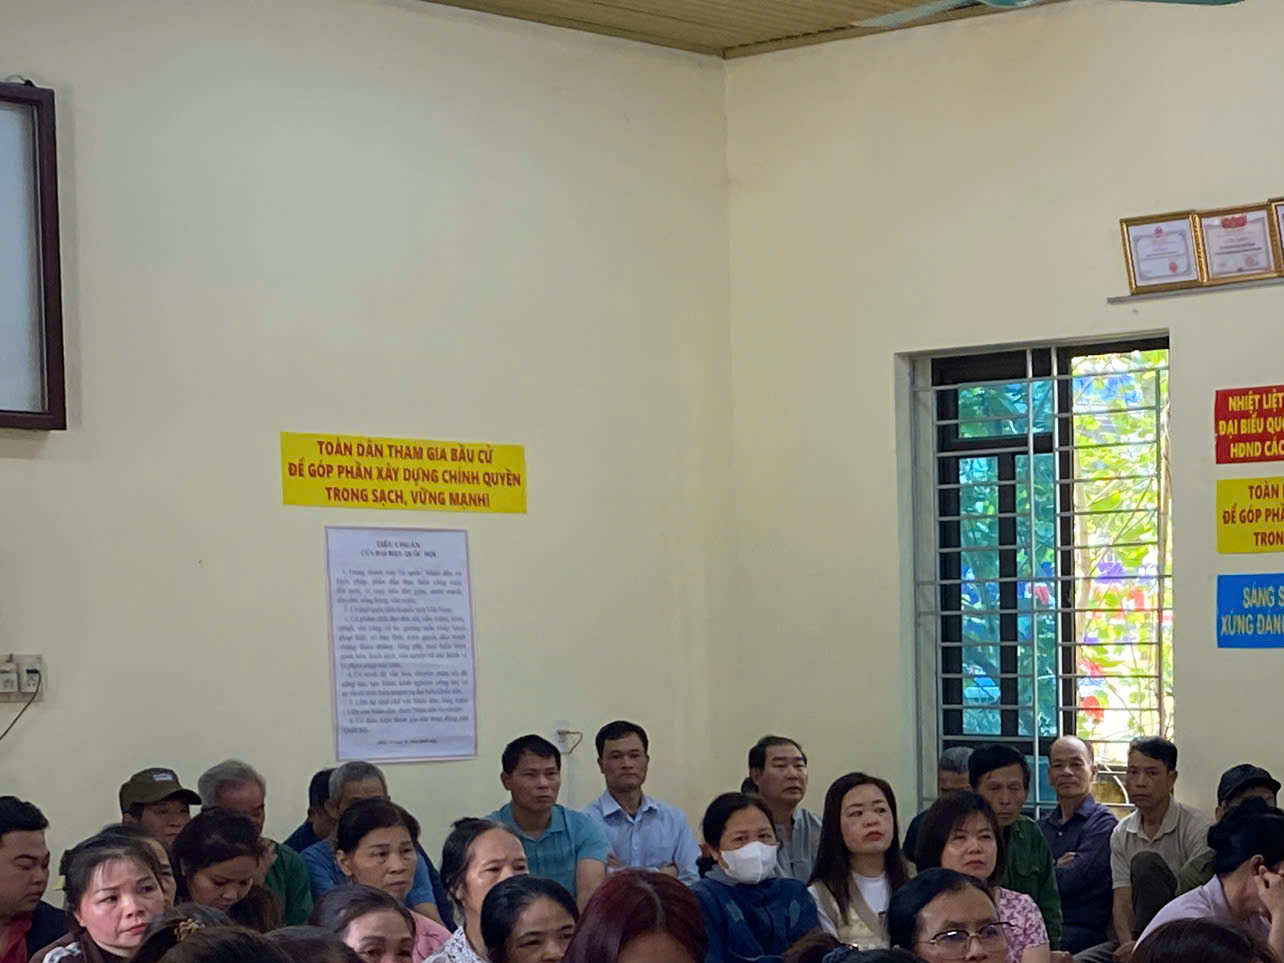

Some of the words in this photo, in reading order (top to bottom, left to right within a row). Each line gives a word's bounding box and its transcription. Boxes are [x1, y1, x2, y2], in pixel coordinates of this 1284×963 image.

[1228, 389, 1261, 414] NHIỆT
[1262, 387, 1284, 413] LIỆT
[1218, 419, 1239, 440] ĐẠI
[1240, 411, 1265, 435] BIỂU
[317, 436, 353, 456] TOÀN
[356, 438, 384, 458] DÂN
[387, 444, 424, 460] THAM
[426, 446, 449, 462] GIA
[450, 443, 475, 464] BẦU
[477, 444, 494, 465] CỬ
[288, 456, 305, 478] ĐỂ
[308, 459, 334, 479] GÓP
[337, 461, 373, 481] PHẦN
[376, 462, 400, 482] XÂY
[403, 467, 440, 486] DỰNG
[441, 466, 481, 485] CHÍNH
[482, 466, 522, 488] QUYỀN
[325, 487, 369, 502] TRONG
[411, 486, 446, 506] VỮNG
[1247, 479, 1281, 501] TOÀN
[1222, 502, 1238, 526] ĐỂ
[1239, 504, 1263, 525] GÓP
